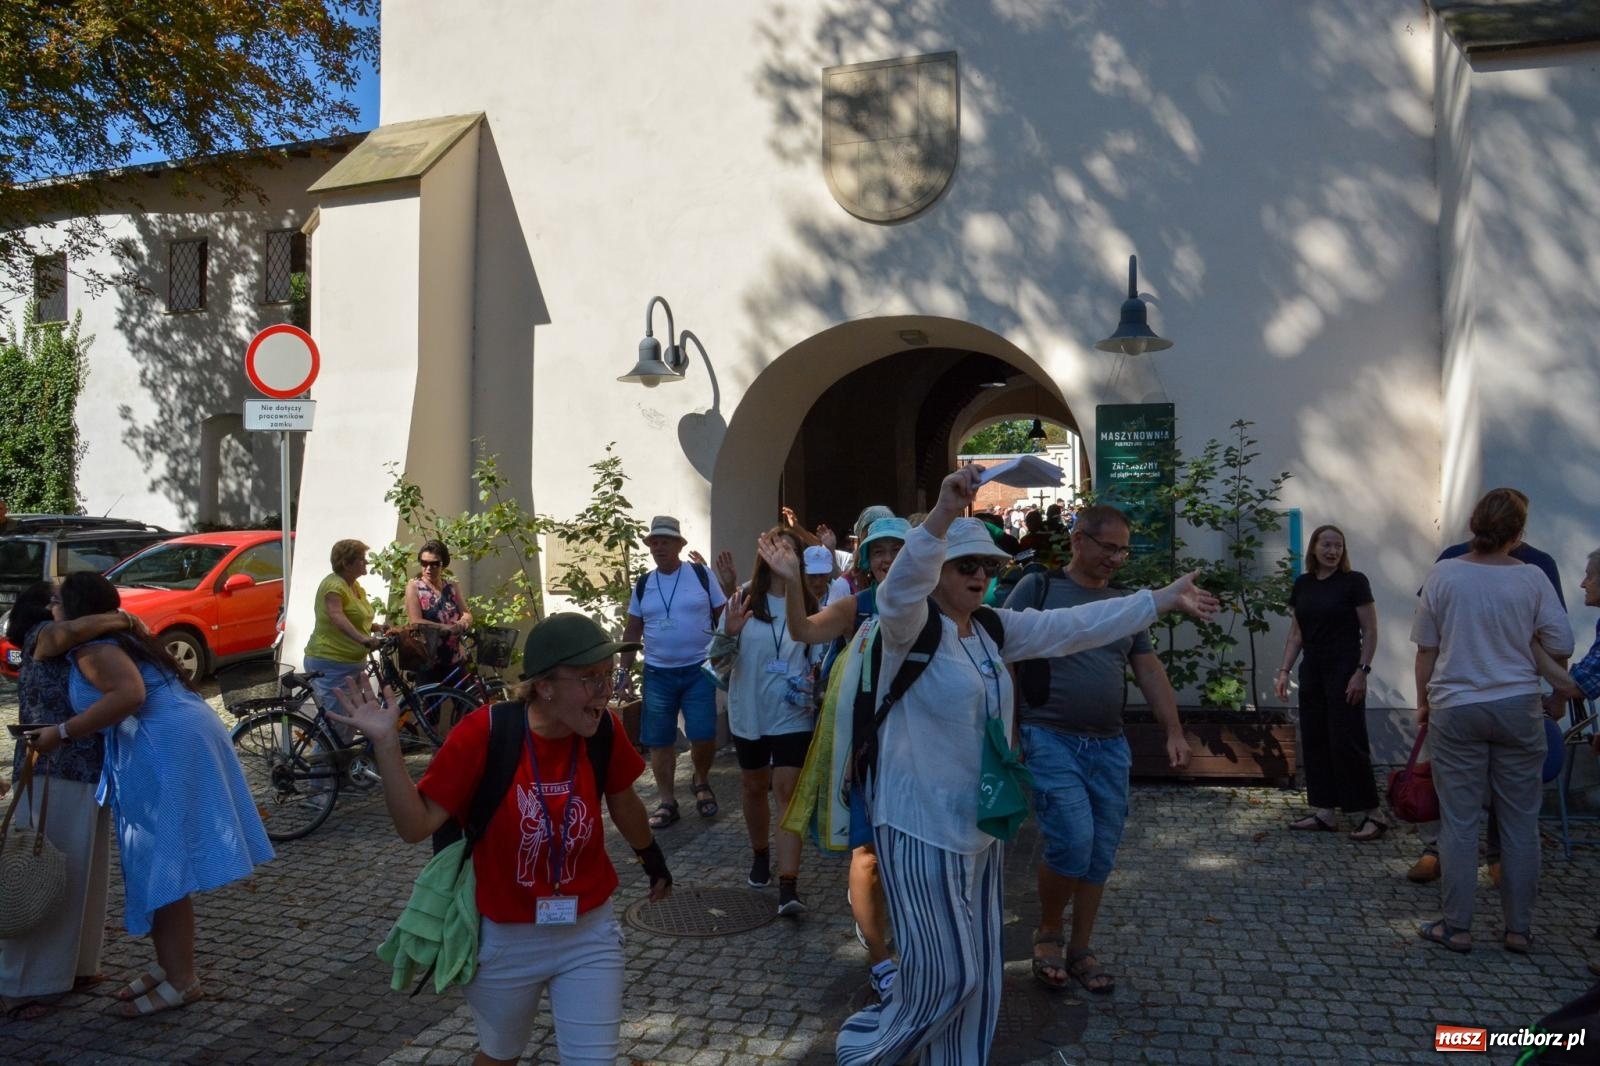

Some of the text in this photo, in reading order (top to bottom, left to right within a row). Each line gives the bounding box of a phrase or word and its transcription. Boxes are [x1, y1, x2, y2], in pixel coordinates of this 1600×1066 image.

[275, 404, 302, 412] dotyczy
[1100, 431, 1169, 441] MASZYNOWNIA
[550, 784, 569, 793] FIRST
